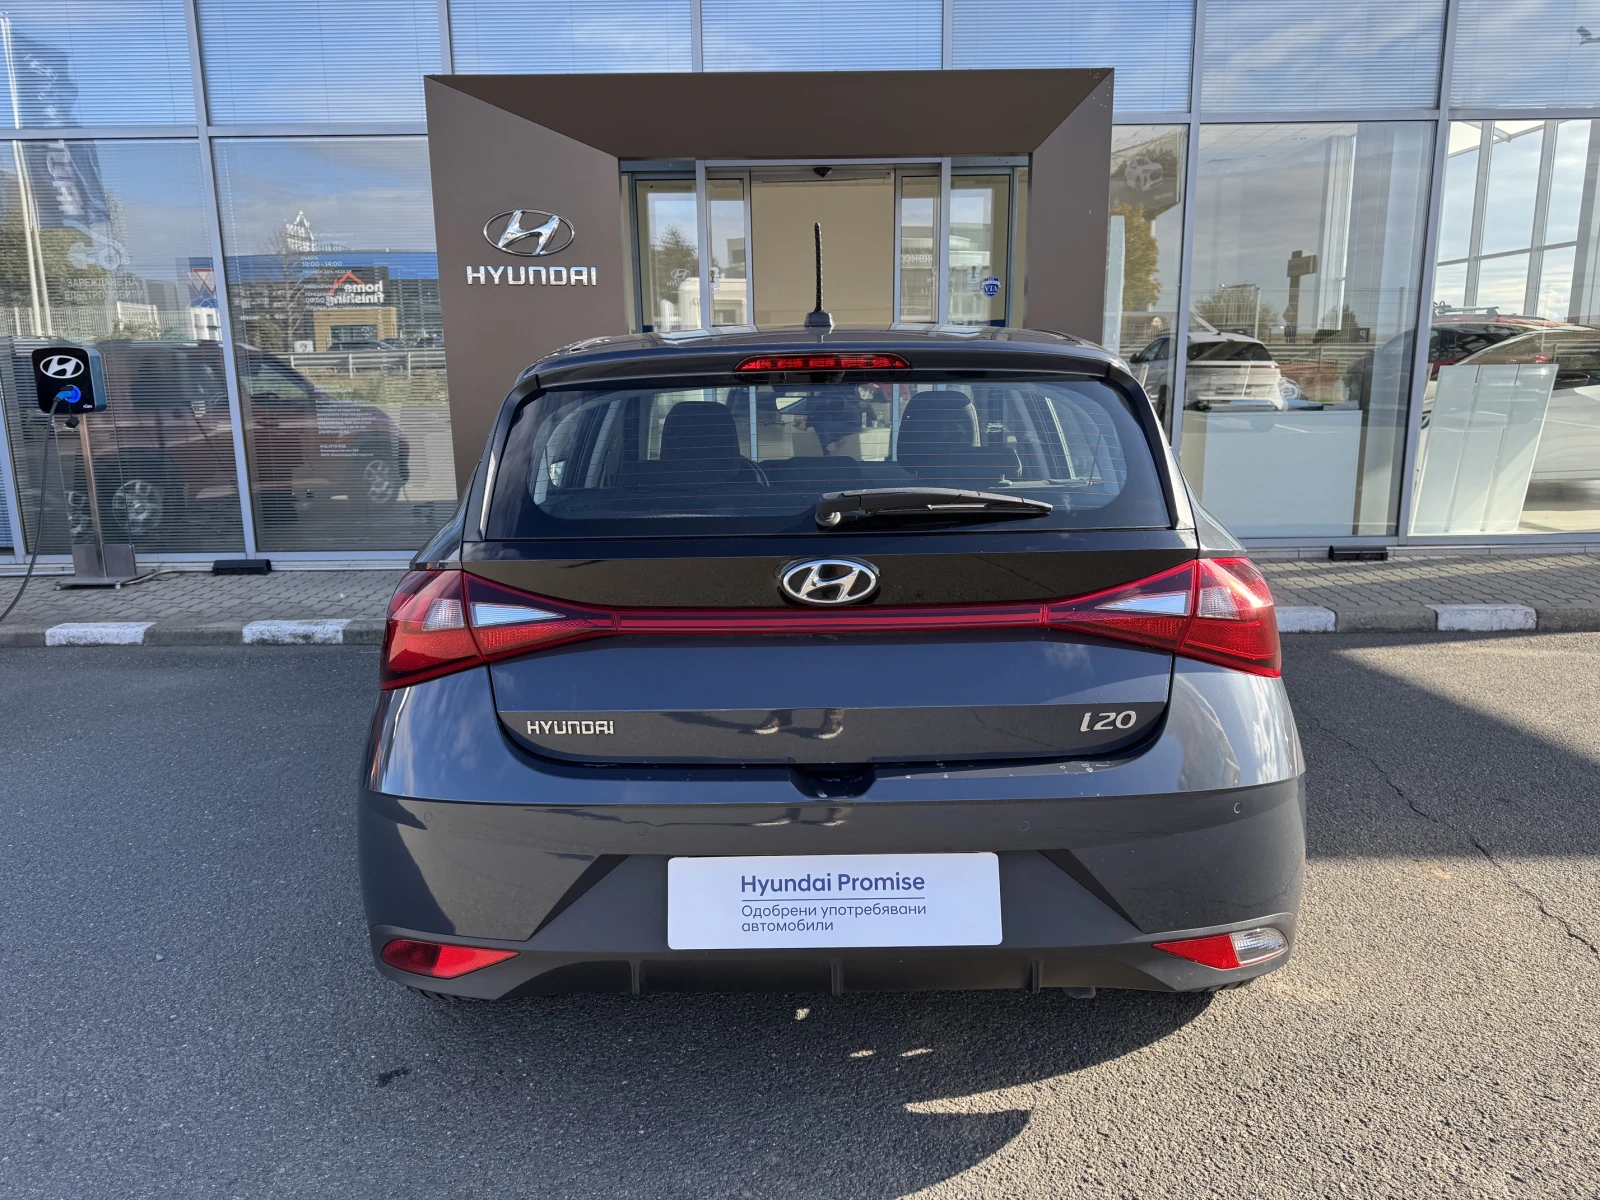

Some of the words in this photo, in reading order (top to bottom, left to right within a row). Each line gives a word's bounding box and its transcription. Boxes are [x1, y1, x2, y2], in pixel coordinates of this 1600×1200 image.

[67, 277, 124, 287] ЗАРЕЖДАНЕ
[125, 277, 138, 287] НА
[466, 265, 597, 286] HYUNDAI
[64, 290, 144, 300] ЕЛЕКТРОМОБИЛИ
[526, 720, 614, 735] HYUNDAI
[1080, 710, 1137, 732] i20
[741, 872, 831, 896] Hyundai
[837, 872, 926, 891] Promise
[741, 904, 817, 919] Одобрени
[820, 902, 927, 918] употребявани
[741, 919, 834, 932] автомобили
